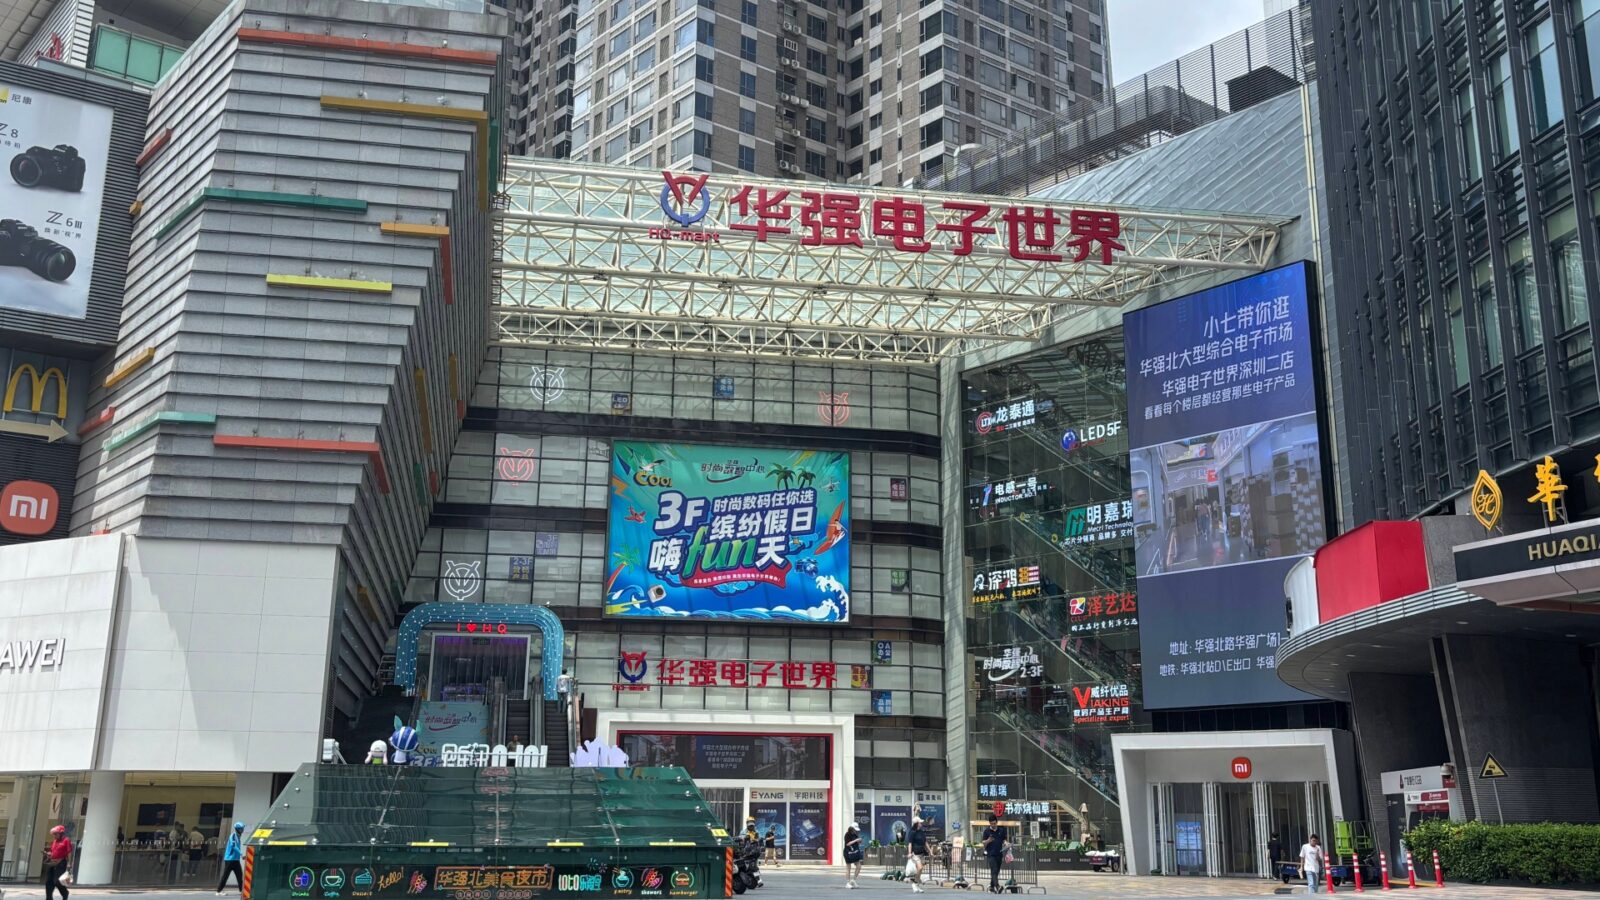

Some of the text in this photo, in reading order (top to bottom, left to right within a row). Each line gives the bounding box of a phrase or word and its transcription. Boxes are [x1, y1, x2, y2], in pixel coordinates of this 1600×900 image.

[730, 185, 1125, 265] 华强电子世界
[1203, 295, 1290, 340] 小七带你逛
[1139, 321, 1293, 378] 华强北大型综合电子市场
[1162, 350, 1295, 398] 华强电子世界深圳二店
[1144, 372, 1296, 420] 看看每个楼层都经营那些电子产品
[996, 400, 1034, 423] 龙泰通
[1080, 425, 1105, 443] LED
[1107, 420, 1121, 436] 5F
[995, 477, 1036, 496] 电感一号
[655, 490, 814, 530] 3F 时尚数码任你选
[711, 506, 813, 540] 缤纷假日
[1528, 533, 1600, 560] HUAQI
[1087, 592, 1137, 616] 泽艺达
[0, 638, 66, 669] AWEI
[656, 659, 837, 689] 华强电子世界
[1020, 665, 1043, 678] 2-3F
[1091, 685, 1128, 698] 威纤优品
[1073, 707, 1129, 717] 数码产品生产商
[751, 791, 784, 799] EYANG
[980, 784, 1008, 796] 明嘉瑞
[1005, 802, 1050, 815] 书亦烧仙草
[438, 869, 548, 887] 华强北美食夜市
